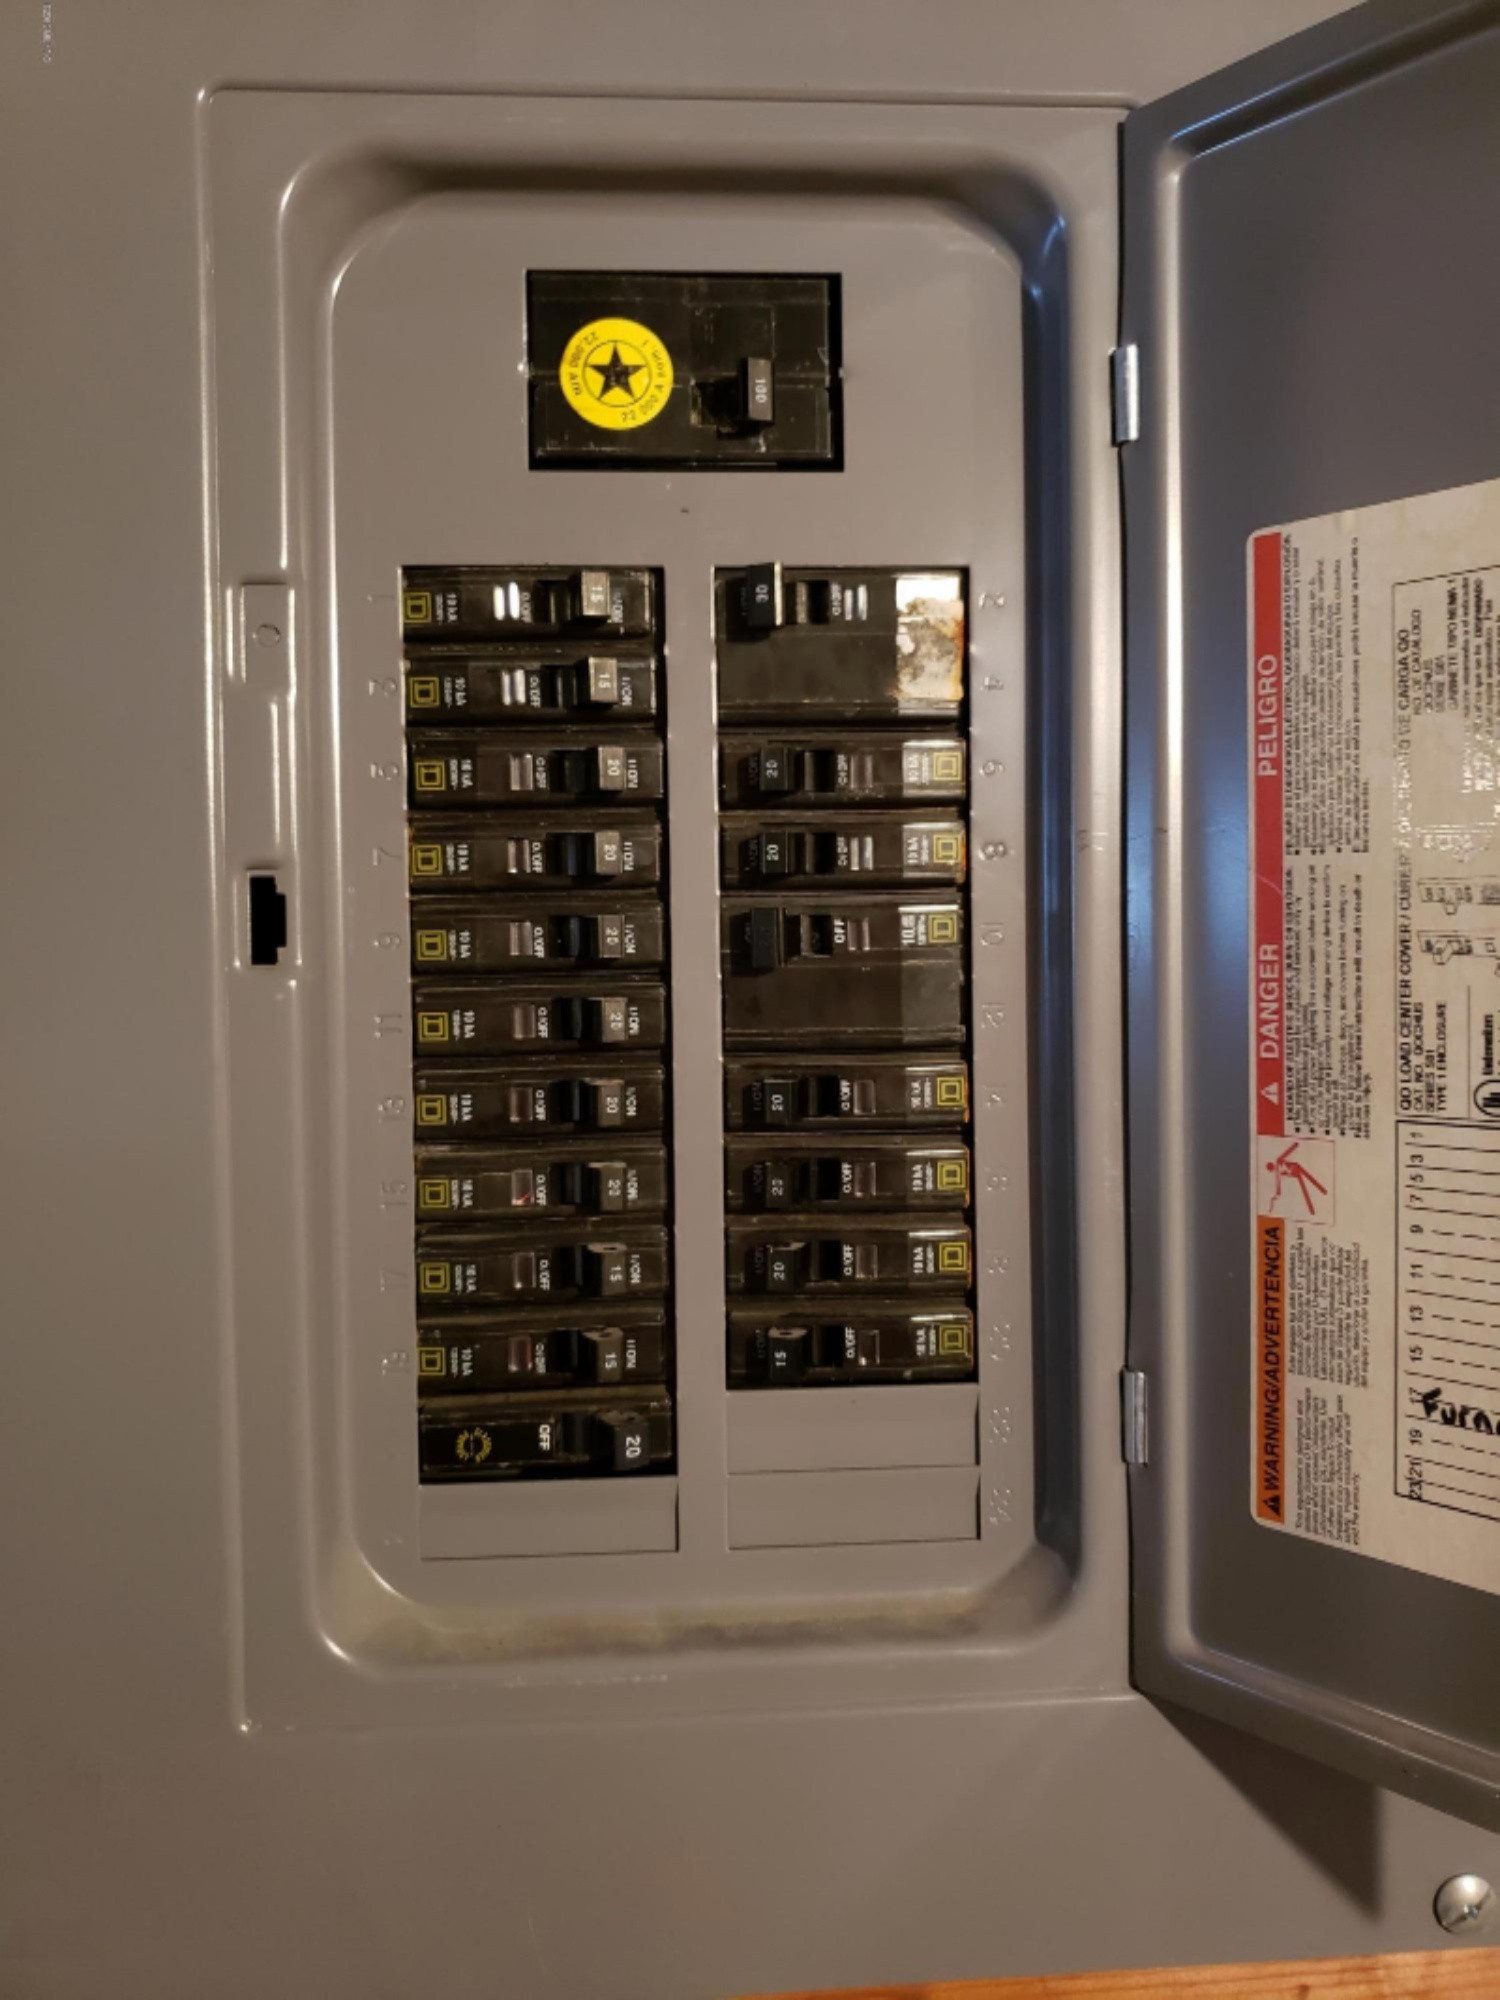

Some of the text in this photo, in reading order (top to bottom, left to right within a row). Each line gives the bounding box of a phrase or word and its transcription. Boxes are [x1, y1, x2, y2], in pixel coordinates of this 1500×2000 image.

[754, 378, 768, 404] 100
[598, 672, 612, 690] 15
[1397, 655, 1411, 711] CARGA
[1256, 655, 1279, 777] PELIGRO
[766, 843, 779, 861] 20
[834, 918, 846, 944] OFF
[1397, 925, 1411, 977] COVER
[1258, 943, 1280, 1060] DANGER
[1398, 979, 1412, 1039] CENTER
[1398, 1087, 1412, 1112] QO
[1408, 1154, 1424, 1164] 3
[1408, 1174, 1424, 1184] 5
[1408, 1194, 1424, 1204] 7
[1408, 1224, 1424, 1235] 9
[609, 1265, 622, 1282] 15
[773, 1262, 786, 1281] 20
[1408, 1264, 1424, 1280] 11
[1408, 1304, 1424, 1323] 13
[605, 1353, 618, 1370] 15
[774, 1350, 787, 1367] 15
[1262, 1226, 1282, 1492] WARNING/ADVERTENCIA
[1408, 1345, 1424, 1363] 15
[1420, 1386, 1500, 1436] Furn
[538, 1423, 551, 1451] OFF
[625, 1434, 642, 1459] 20
[1408, 1428, 1422, 1446] 19
[1408, 1460, 1422, 1478] 21
[1408, 1480, 1422, 1499] 23
